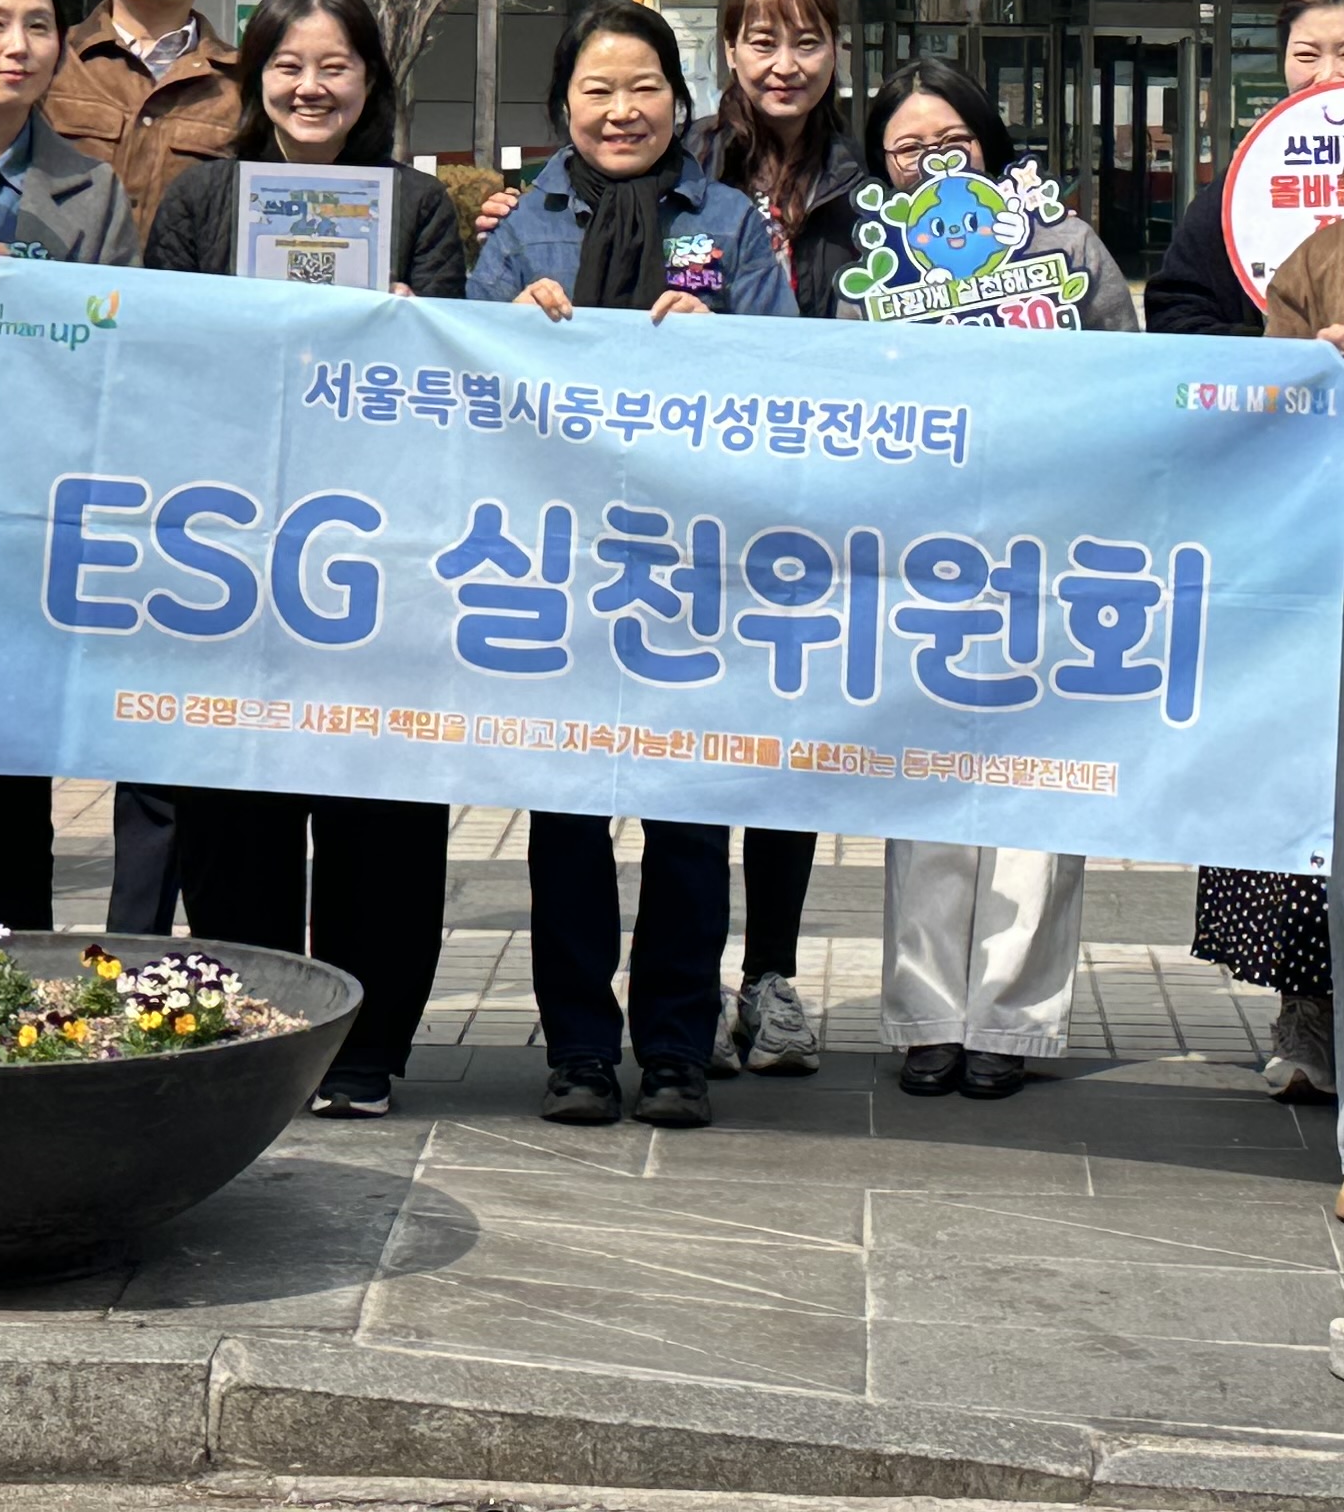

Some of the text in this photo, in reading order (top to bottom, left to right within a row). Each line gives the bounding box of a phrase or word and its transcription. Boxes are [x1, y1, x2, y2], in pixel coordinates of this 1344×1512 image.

[51, 322, 90, 351] up
[305, 362, 969, 464] 서울특별시동부여성발전센터
[47, 478, 1204, 724] ESG 실천위원회
[116, 693, 176, 721] ESG
[184, 695, 292, 730] 경영으로
[300, 702, 379, 736] 사회적
[388, 707, 467, 743] 책임을
[474, 716, 555, 748] 다하고
[562, 721, 696, 760] 지속가능한
[702, 734, 780, 767] 미래를
[788, 740, 896, 775] 실현하는
